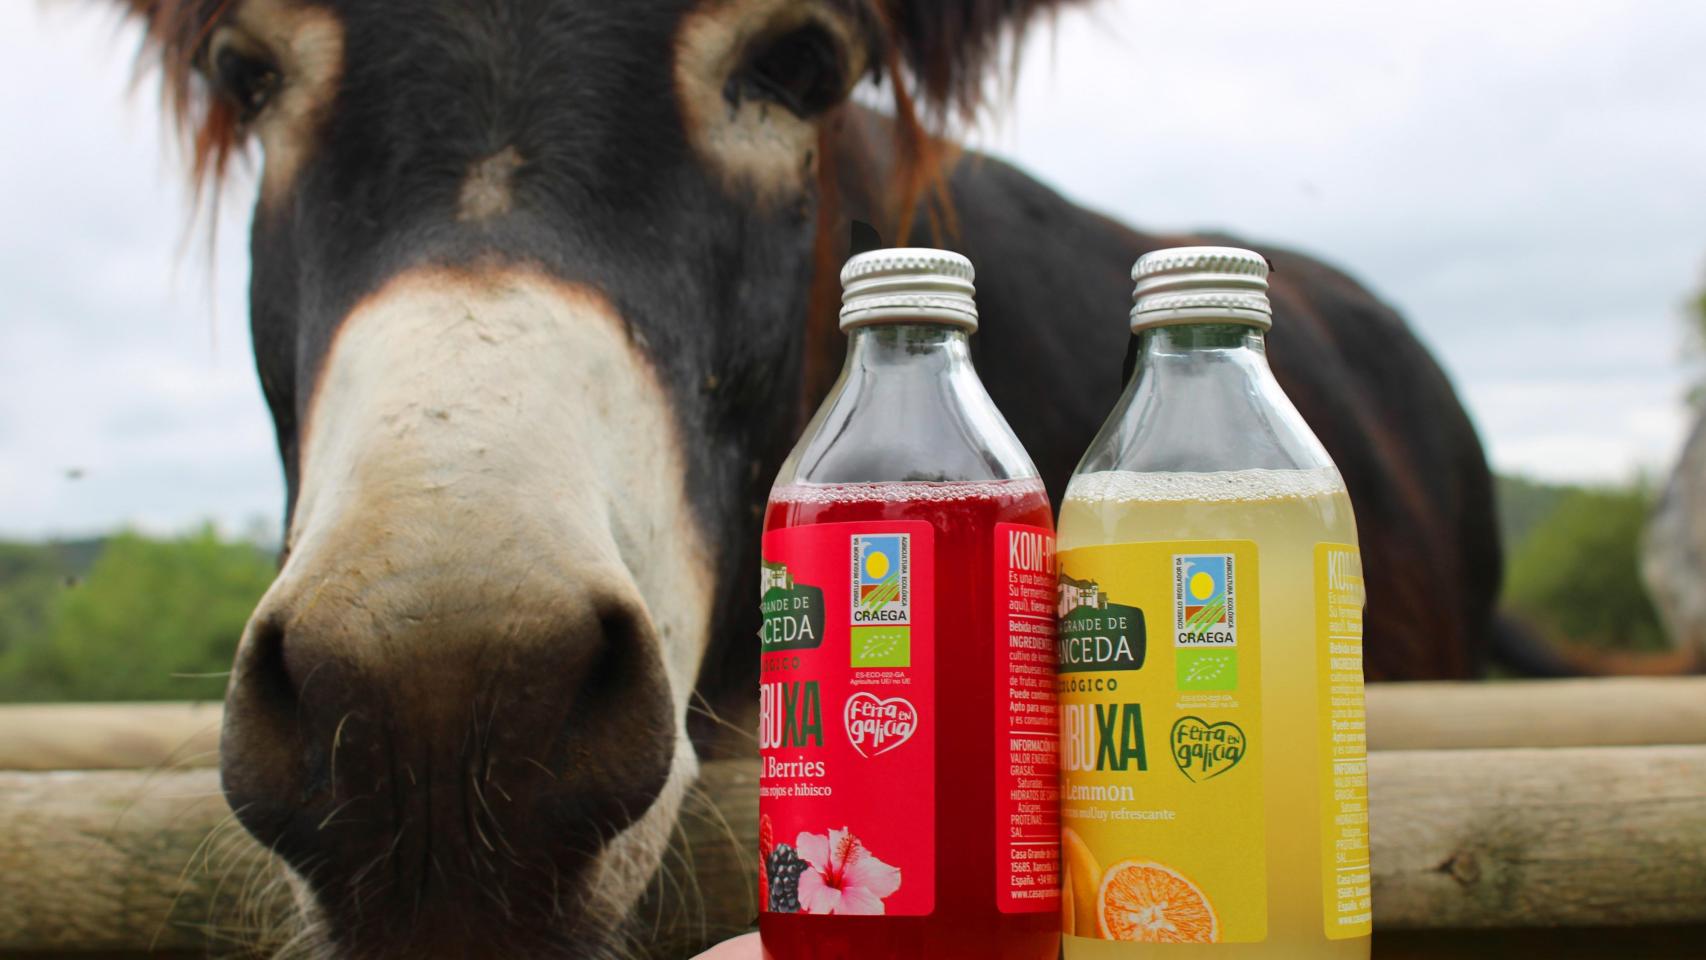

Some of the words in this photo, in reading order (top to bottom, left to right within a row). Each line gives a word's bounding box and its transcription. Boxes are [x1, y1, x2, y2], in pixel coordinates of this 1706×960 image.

[794, 596, 810, 610] DE
[854, 610, 907, 622] CRAEGA
[1108, 616, 1128, 630] DE
[1178, 632, 1234, 644] CRAEGA
[768, 755, 825, 778] Berries
[794, 782, 832, 796] hibisco
[1111, 807, 1176, 820] refrescante
